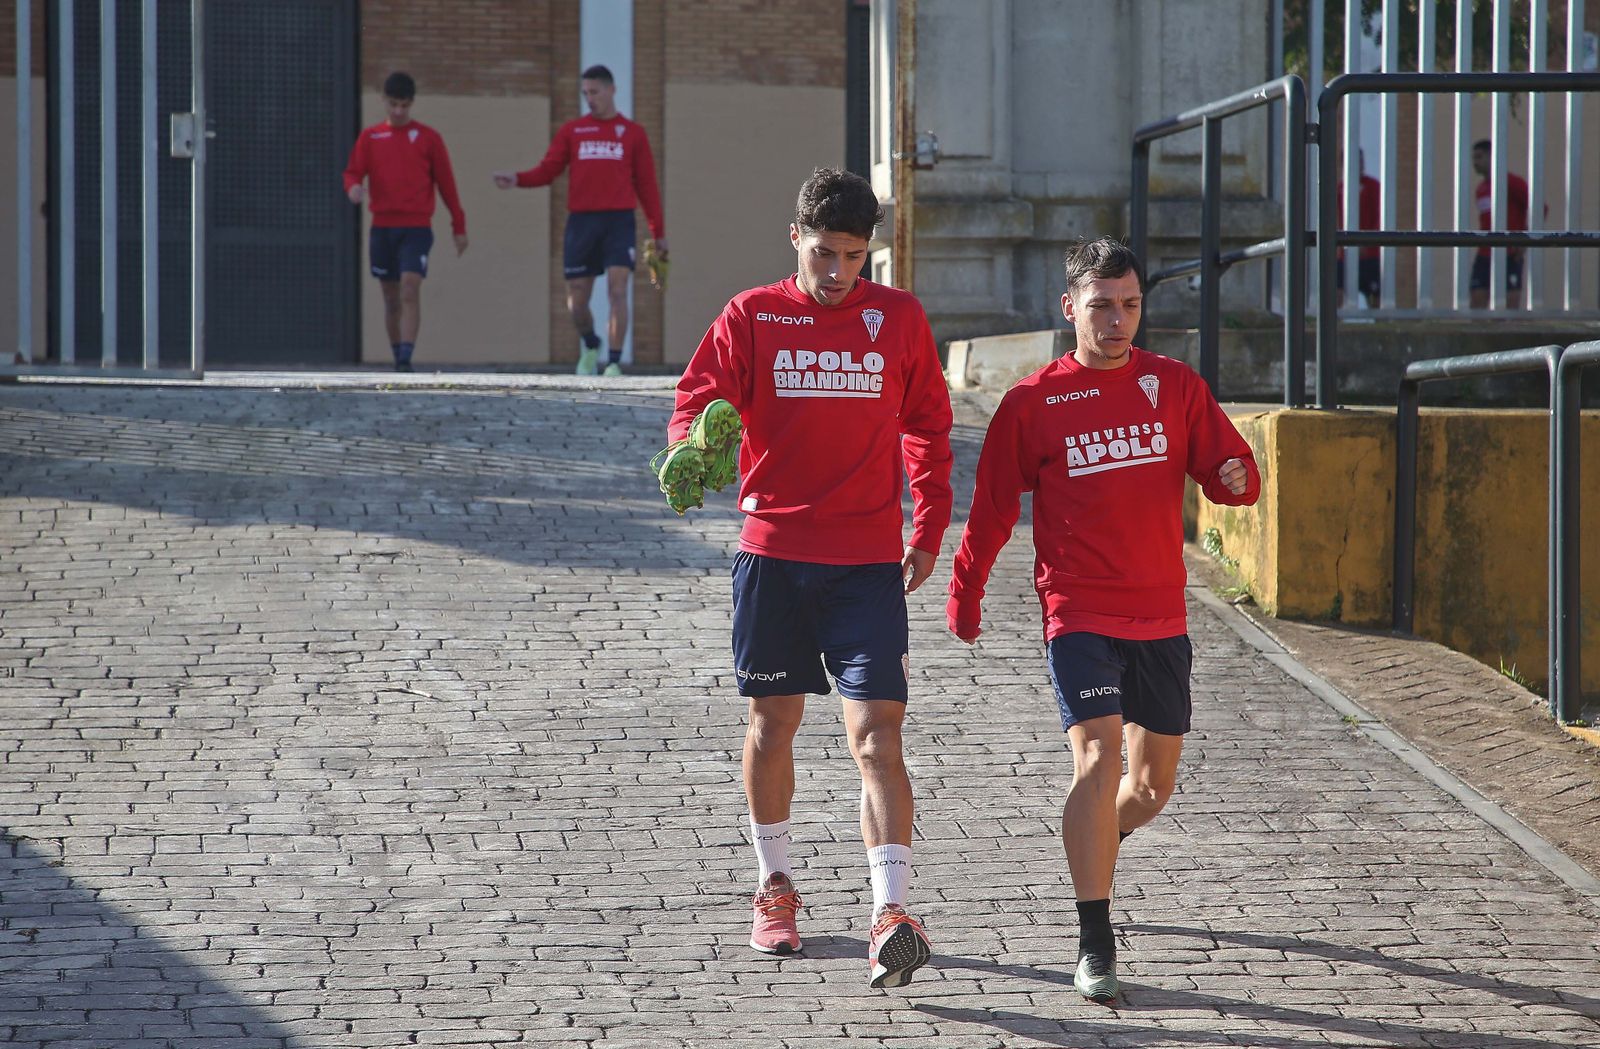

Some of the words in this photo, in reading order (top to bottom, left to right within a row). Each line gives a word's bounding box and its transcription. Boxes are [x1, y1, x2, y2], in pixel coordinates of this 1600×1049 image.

[756, 312, 814, 325] GIVOVA
[773, 350, 885, 373] APOLO
[773, 371, 884, 392] BRANDING
[1046, 388, 1100, 405] GIVOVA
[1065, 422, 1164, 447] UNIVERSO
[1066, 434, 1168, 467] APOLO
[737, 669, 787, 682] GIVOVA
[871, 859, 907, 868] VOVA
